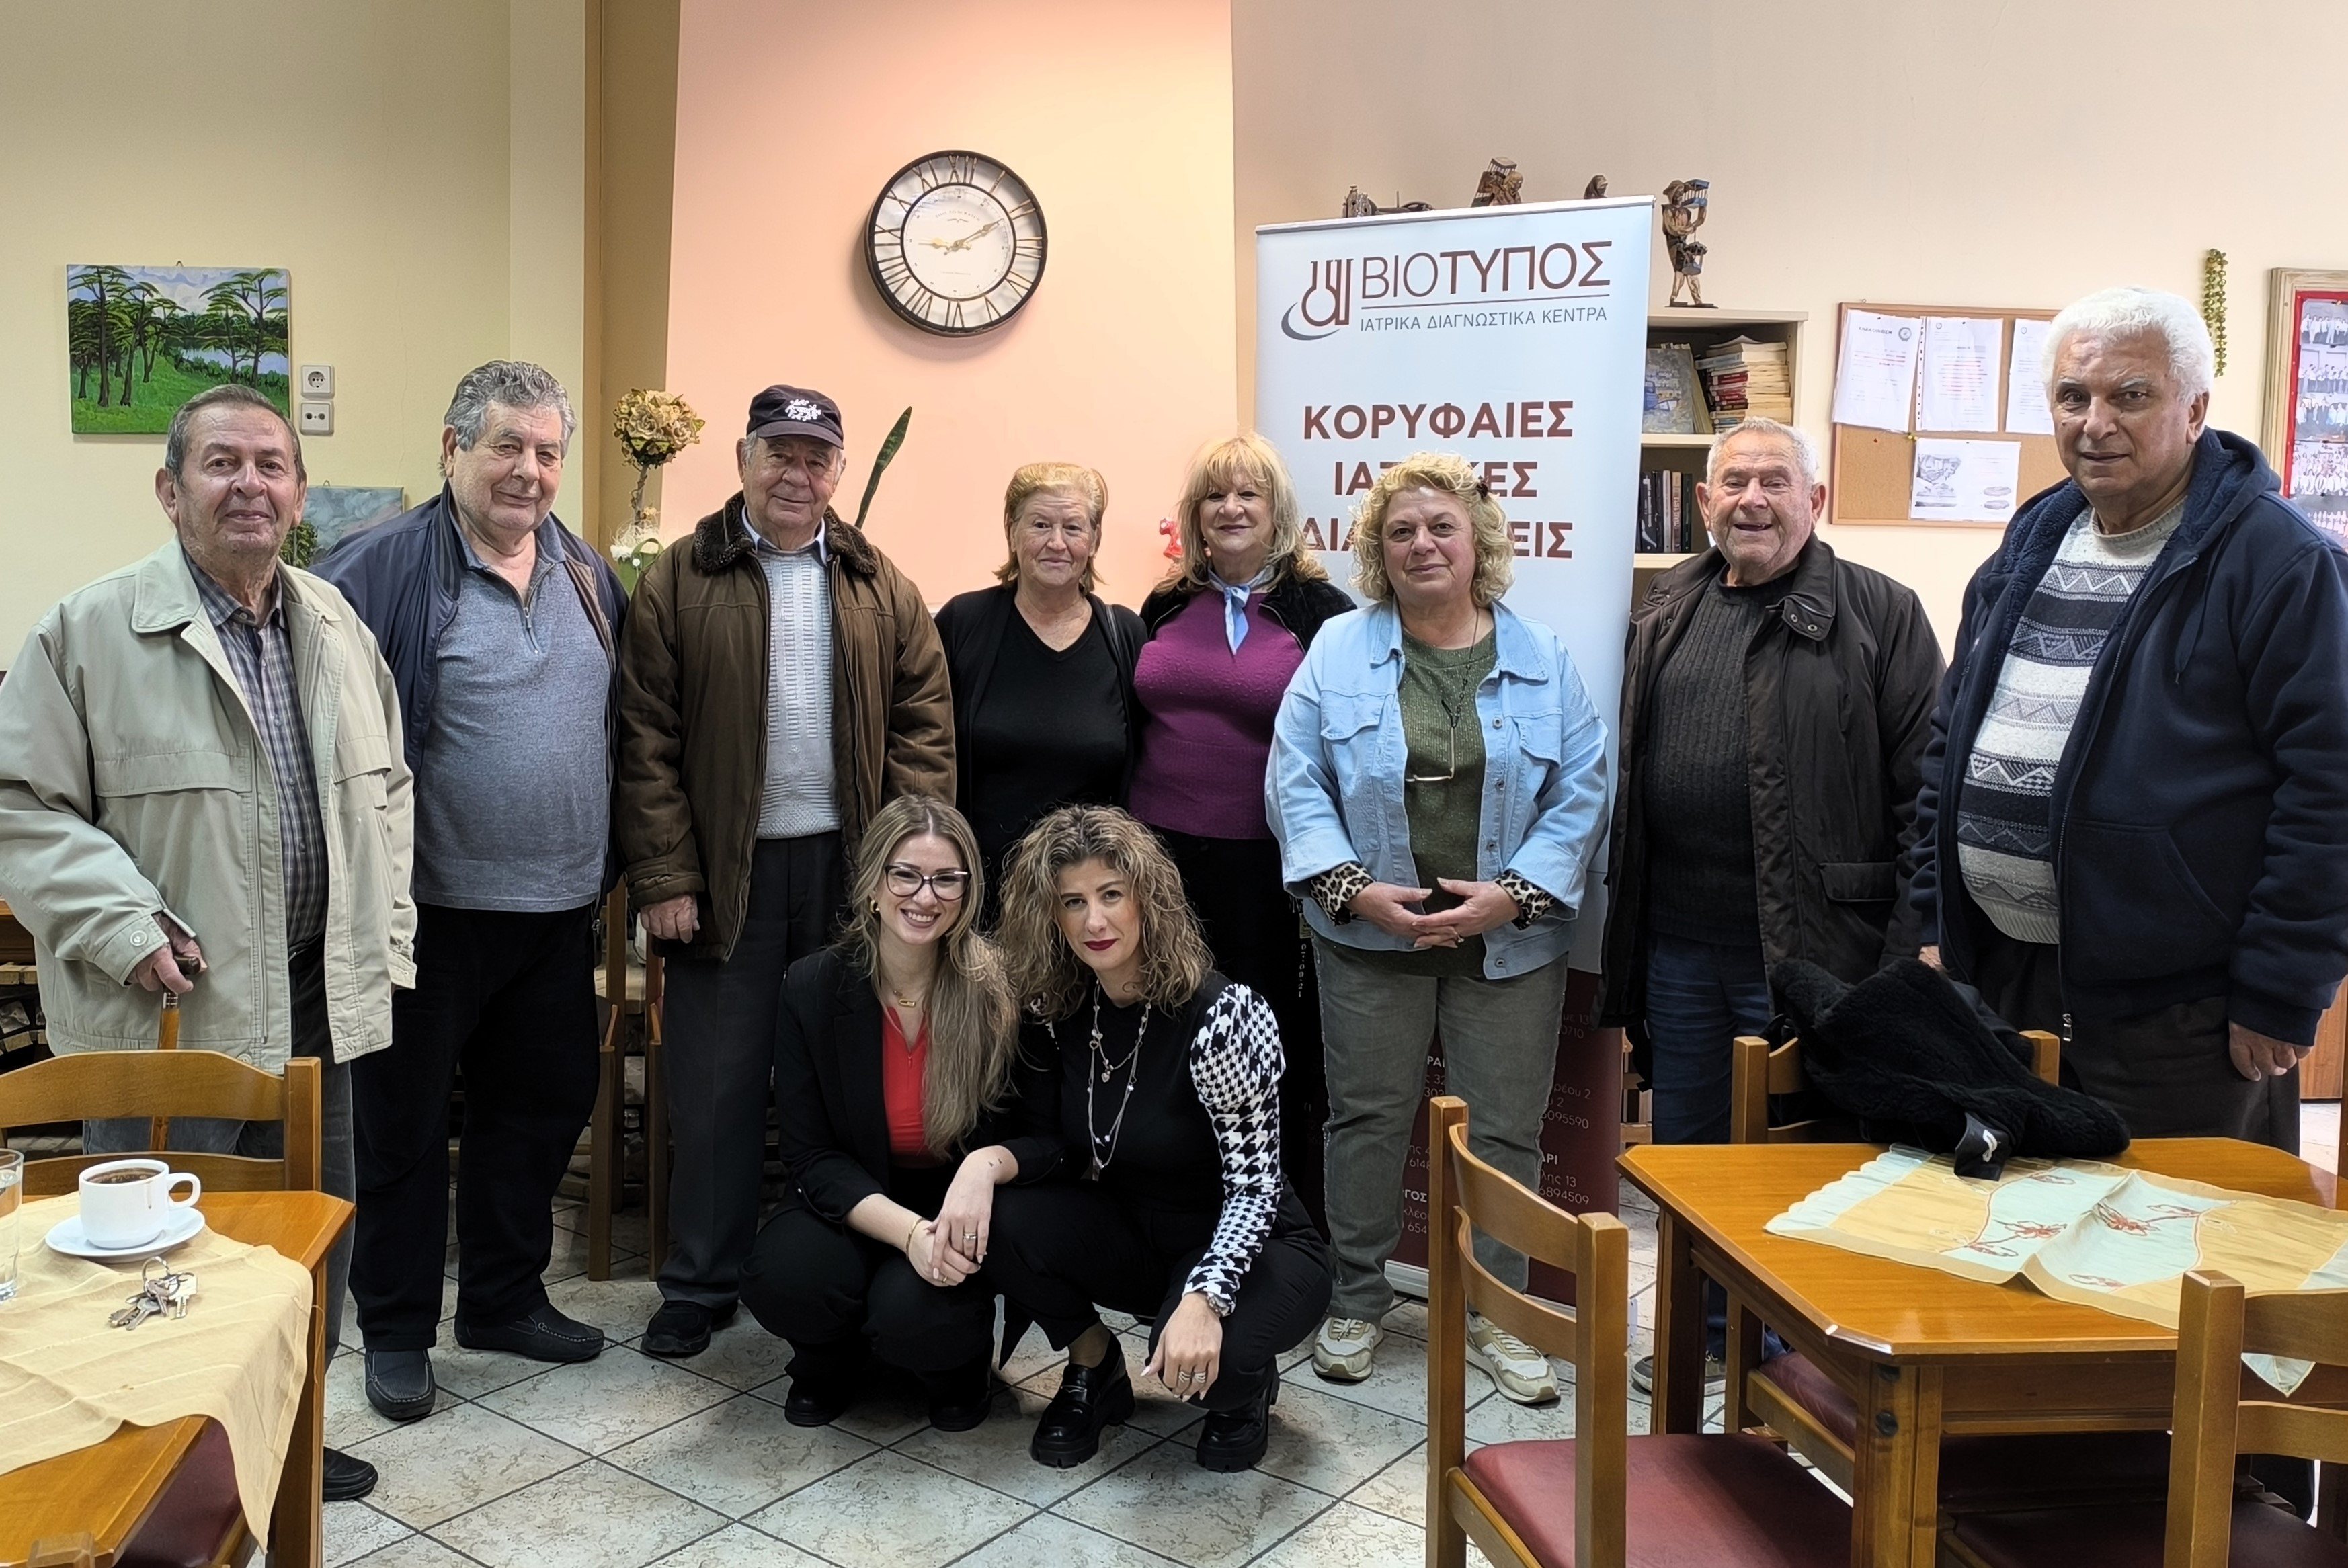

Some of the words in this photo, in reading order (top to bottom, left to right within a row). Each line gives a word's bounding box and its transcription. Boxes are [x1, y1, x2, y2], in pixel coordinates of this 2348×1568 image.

[1361, 240, 1613, 300] ΒΙΟΤΥΠΟΣ
[1360, 316, 1422, 332] ΙΑΤΡΙΚΑ
[1426, 310, 1536, 329] ΔΙΑΓΝΩΣΤΙΚΑ
[1542, 306, 1608, 323] ΚΕΝΤΡΑ
[1303, 401, 1574, 440] ΚΟΡΥΦΑΙΕΣ
[1334, 461, 1538, 497] ΙΑΕΣ
[1557, 1097, 1564, 1108] 2
[1584, 1088, 1591, 1100] 2
[1566, 1175, 1576, 1188] 13
